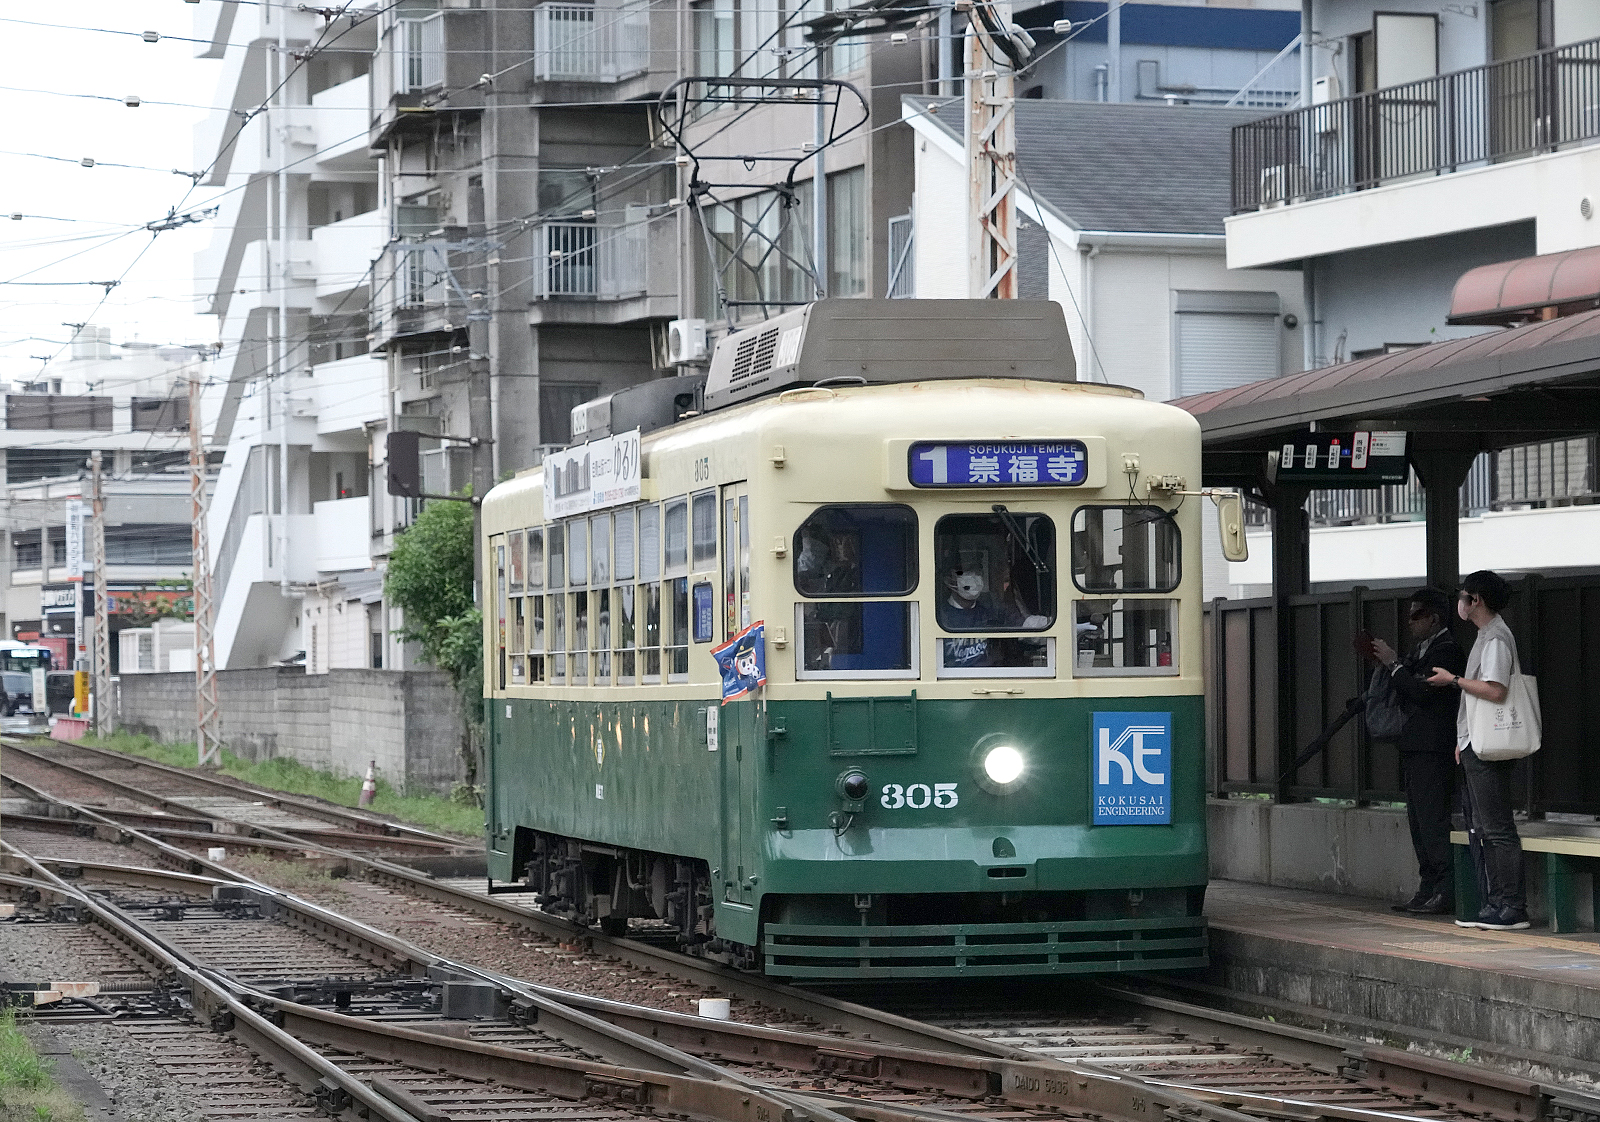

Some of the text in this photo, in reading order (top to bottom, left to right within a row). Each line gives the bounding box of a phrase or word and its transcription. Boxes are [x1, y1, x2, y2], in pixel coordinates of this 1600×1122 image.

[613, 437, 638, 483] ゆるり
[968, 444, 1077, 455] SOFUKUJI TEMPLE
[919, 446, 948, 483] 1
[968, 455, 1078, 483] 崇福寺
[1098, 725, 1165, 785] KE
[880, 782, 959, 809] 305
[1098, 796, 1164, 805] KOKUSAI
[1098, 806, 1165, 816] ENGINEERING
